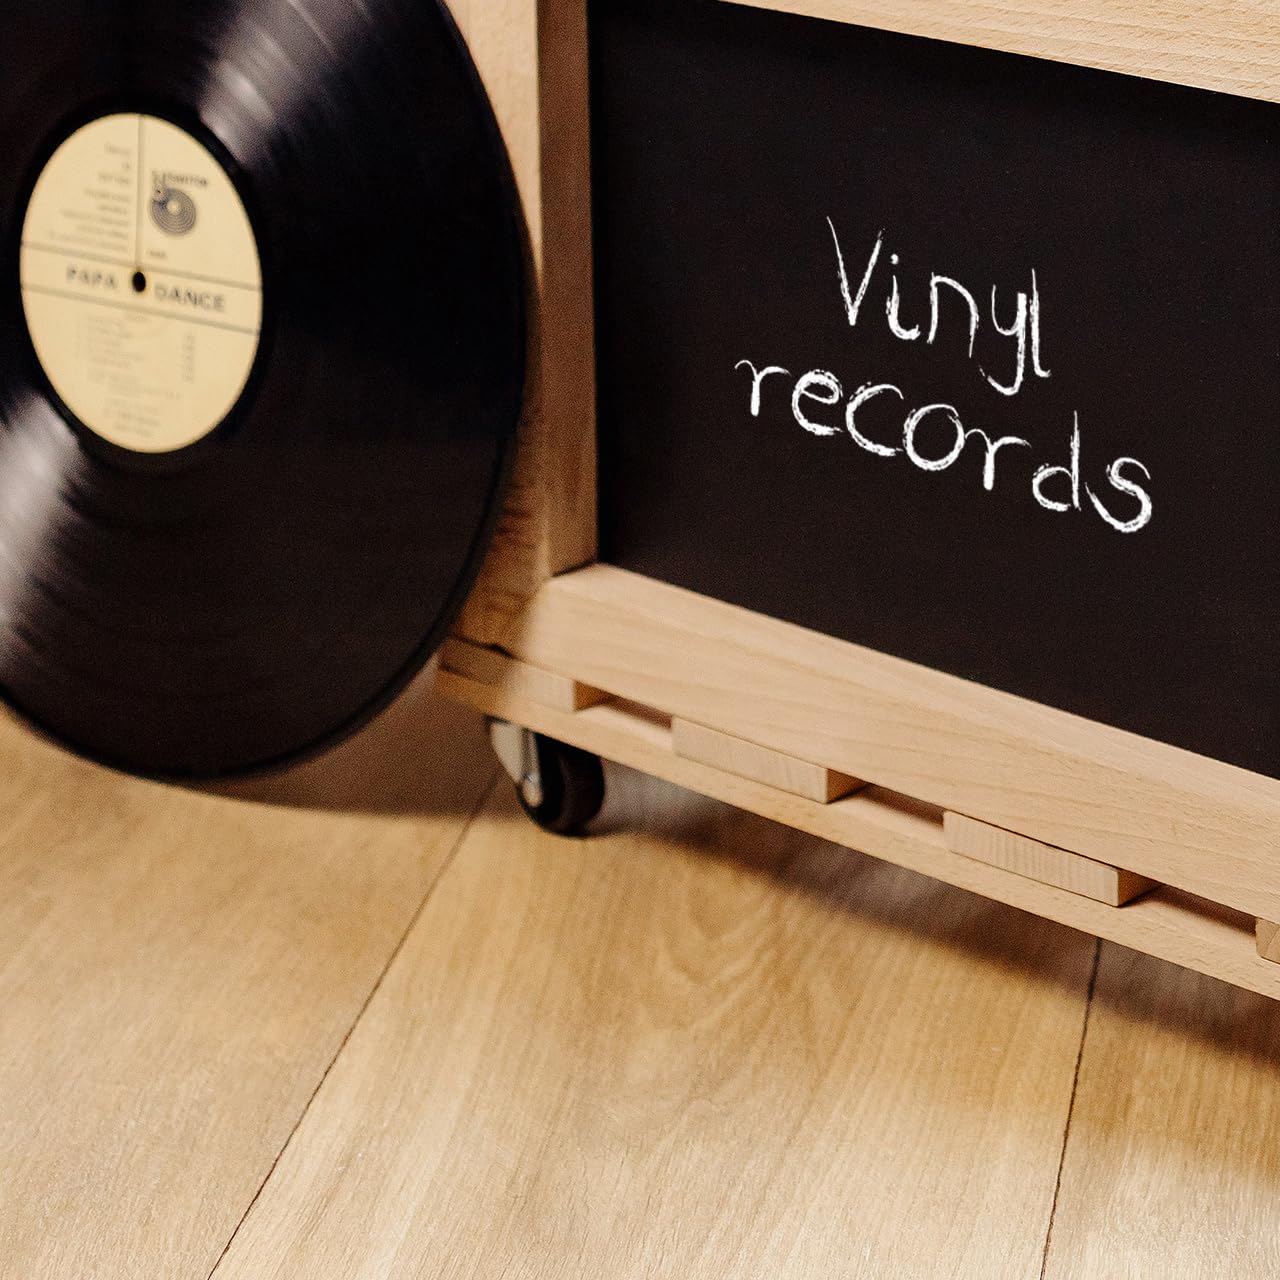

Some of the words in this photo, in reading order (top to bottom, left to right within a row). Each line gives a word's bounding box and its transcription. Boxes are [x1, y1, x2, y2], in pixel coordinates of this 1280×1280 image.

[66, 264, 118, 290] PAPA
[154, 283, 226, 312] DANCE
[826, 216, 1052, 396] Vinyl
[734, 359, 1153, 534] records
